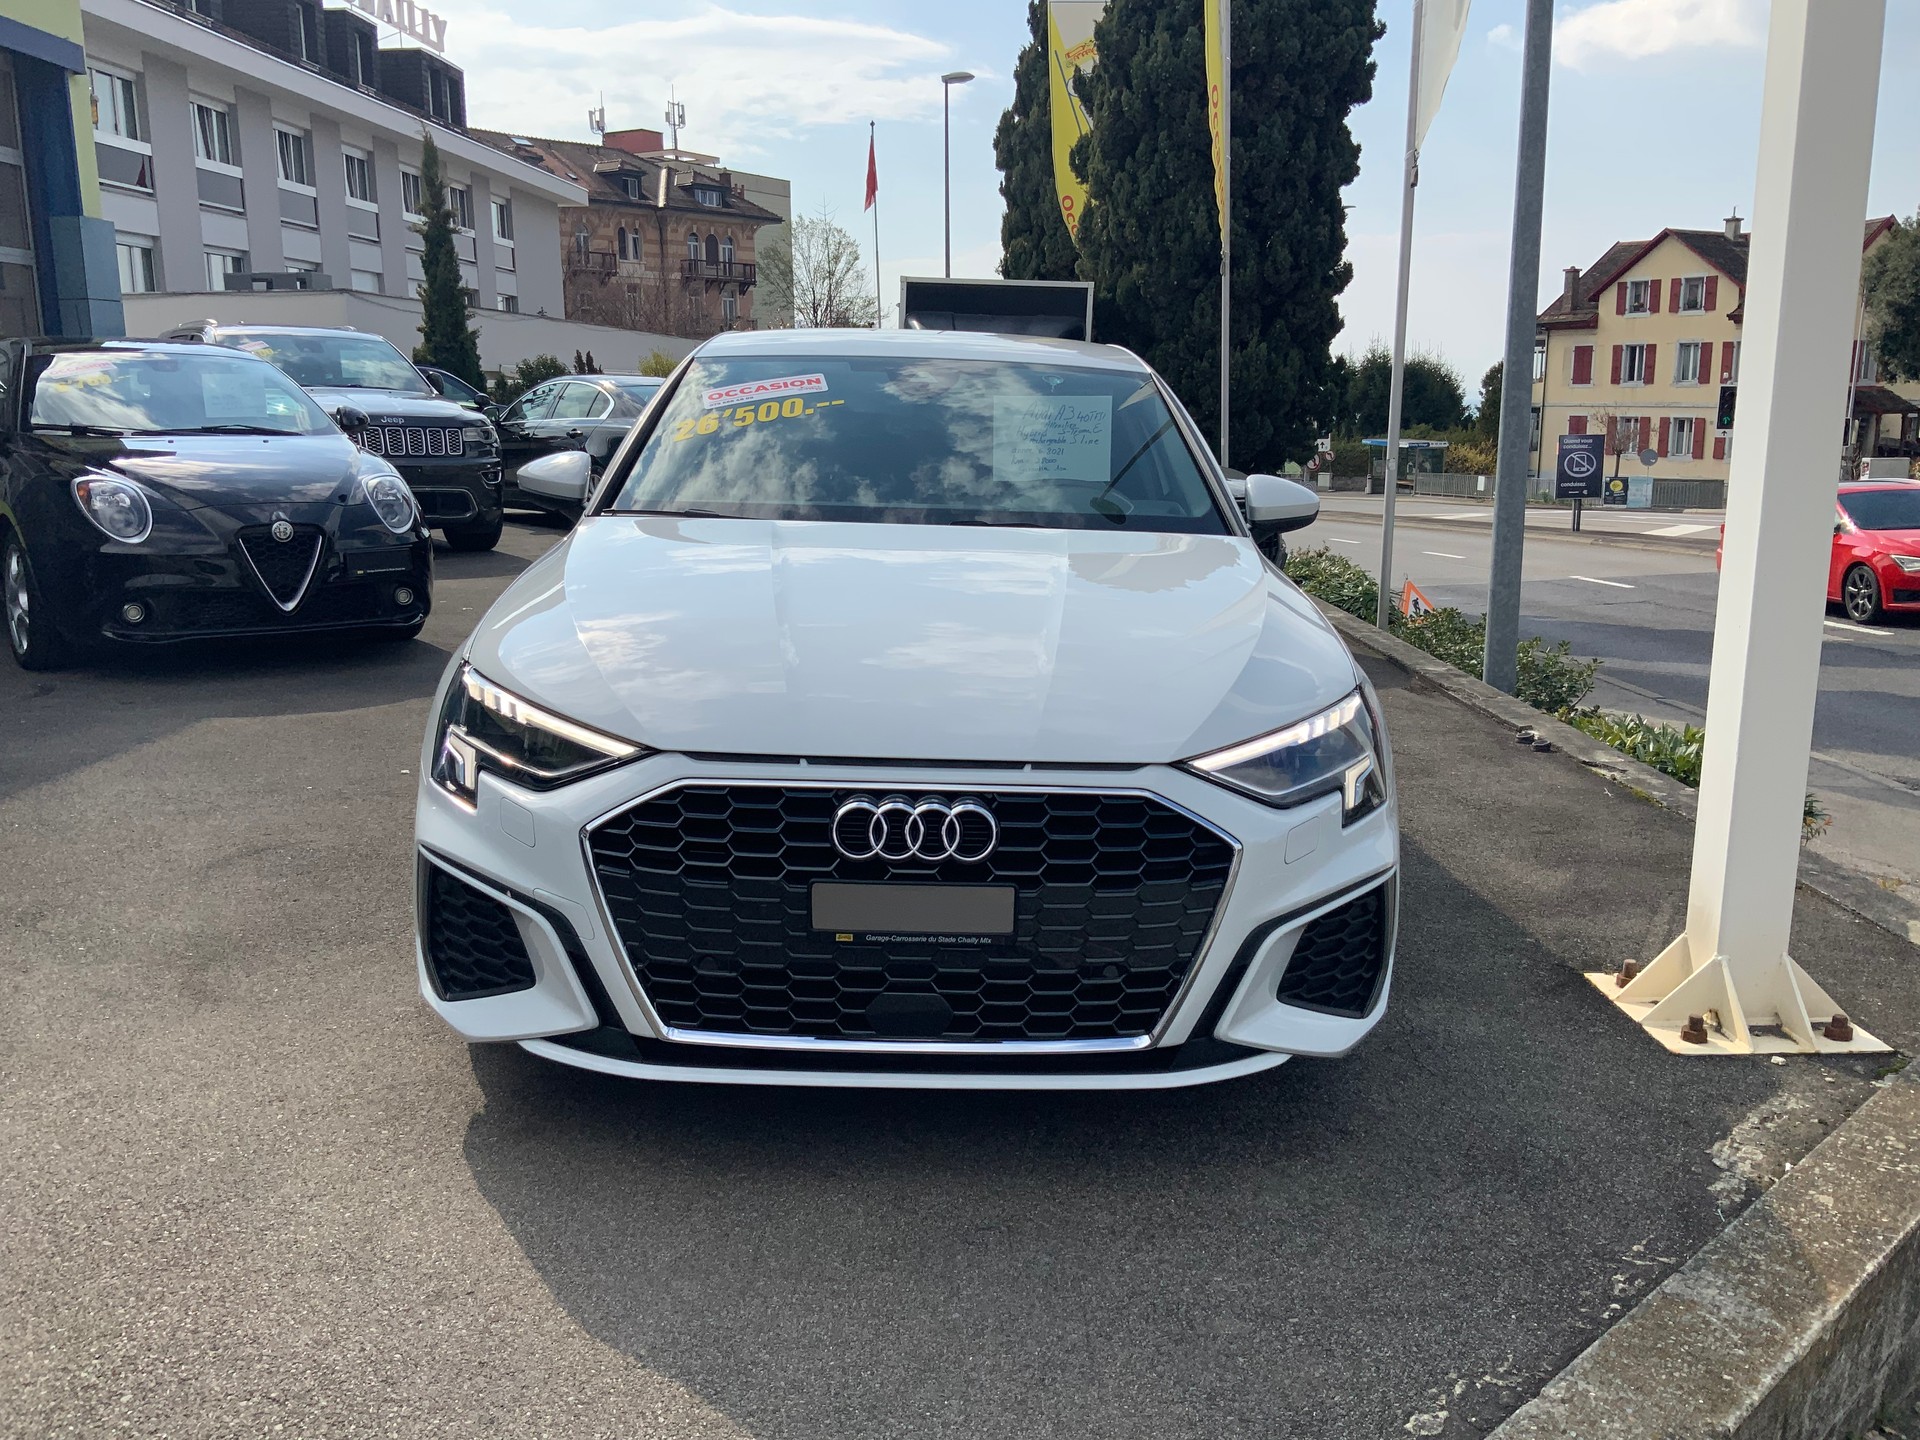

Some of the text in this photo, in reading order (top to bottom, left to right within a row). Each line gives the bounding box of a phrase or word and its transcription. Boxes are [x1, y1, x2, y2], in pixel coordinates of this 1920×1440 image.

[343, 0, 448, 52] AILLY
[707, 377, 822, 401] OCCASION
[381, 416, 405, 424] Jeep
[673, 397, 845, 442] 26'500.--
[1054, 405, 1075, 420] A3
[938, 935, 956, 943] Stade
[957, 936, 979, 944] Chailly
